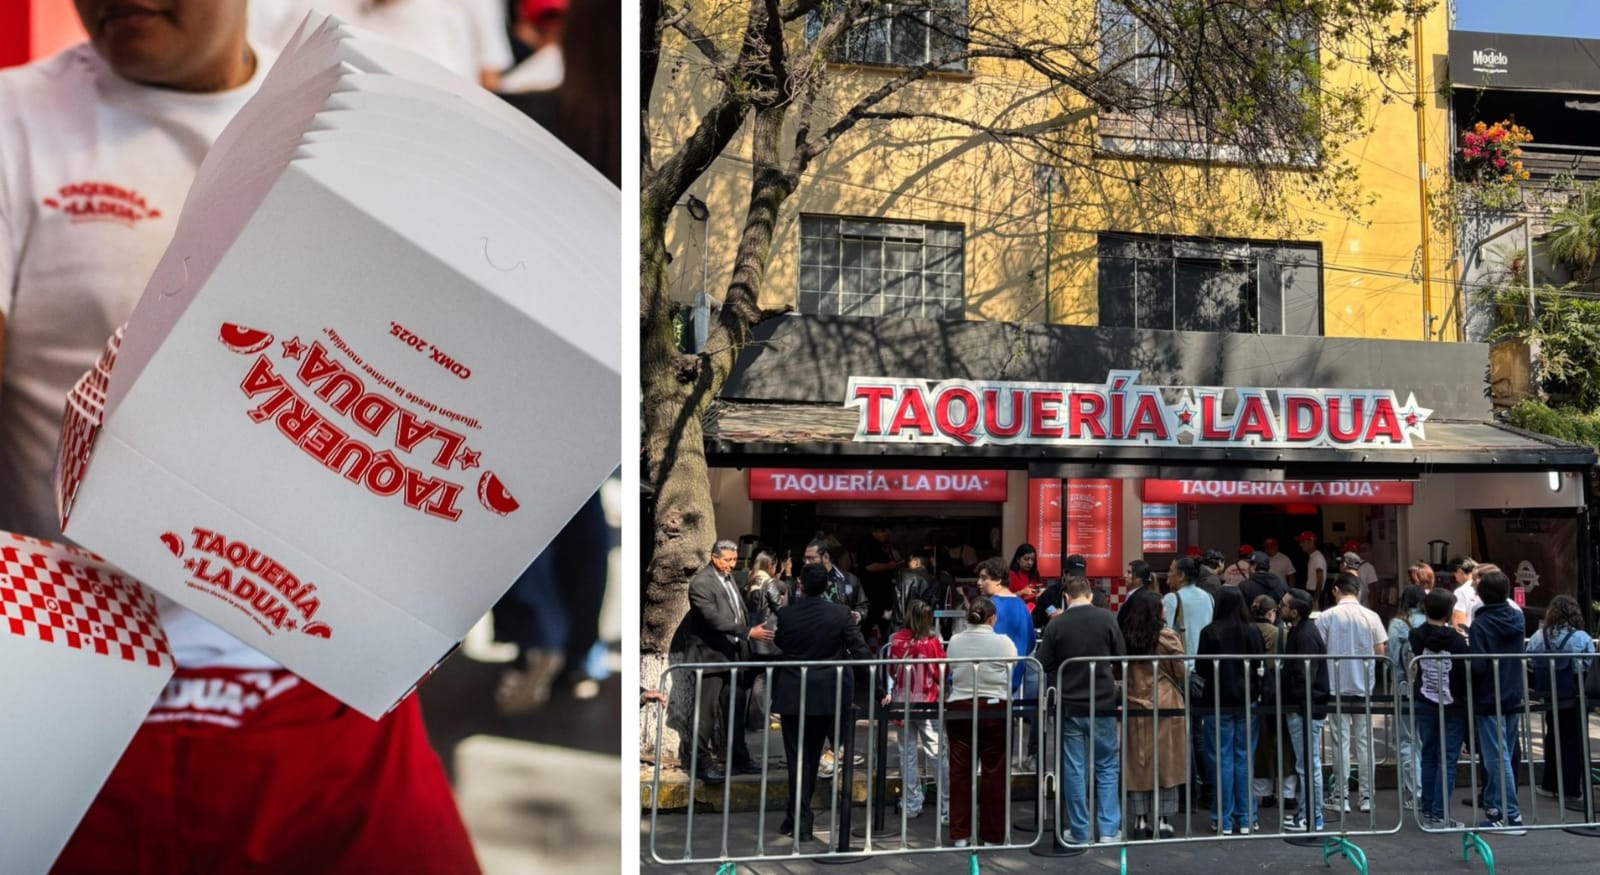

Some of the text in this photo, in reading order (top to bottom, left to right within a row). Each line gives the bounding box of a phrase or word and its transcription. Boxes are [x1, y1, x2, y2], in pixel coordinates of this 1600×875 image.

[1472, 50, 1508, 65] Modelo
[390, 321, 471, 380] CDMX, 2025.
[362, 363, 395, 391] primer
[395, 386, 406, 397] la
[297, 340, 467, 470] LA DUA
[406, 392, 439, 415] desde
[853, 378, 1405, 446] TAQUERÍA LA DUA
[241, 353, 465, 522] TAQUERÍA
[770, 470, 983, 494] TAQUERÍA LA DUA
[1298, 481, 1326, 496] LA
[1329, 481, 1373, 497] DUA
[191, 526, 321, 621] TAQUERÍA
[193, 557, 234, 592] LA
[231, 575, 291, 630] DUA
